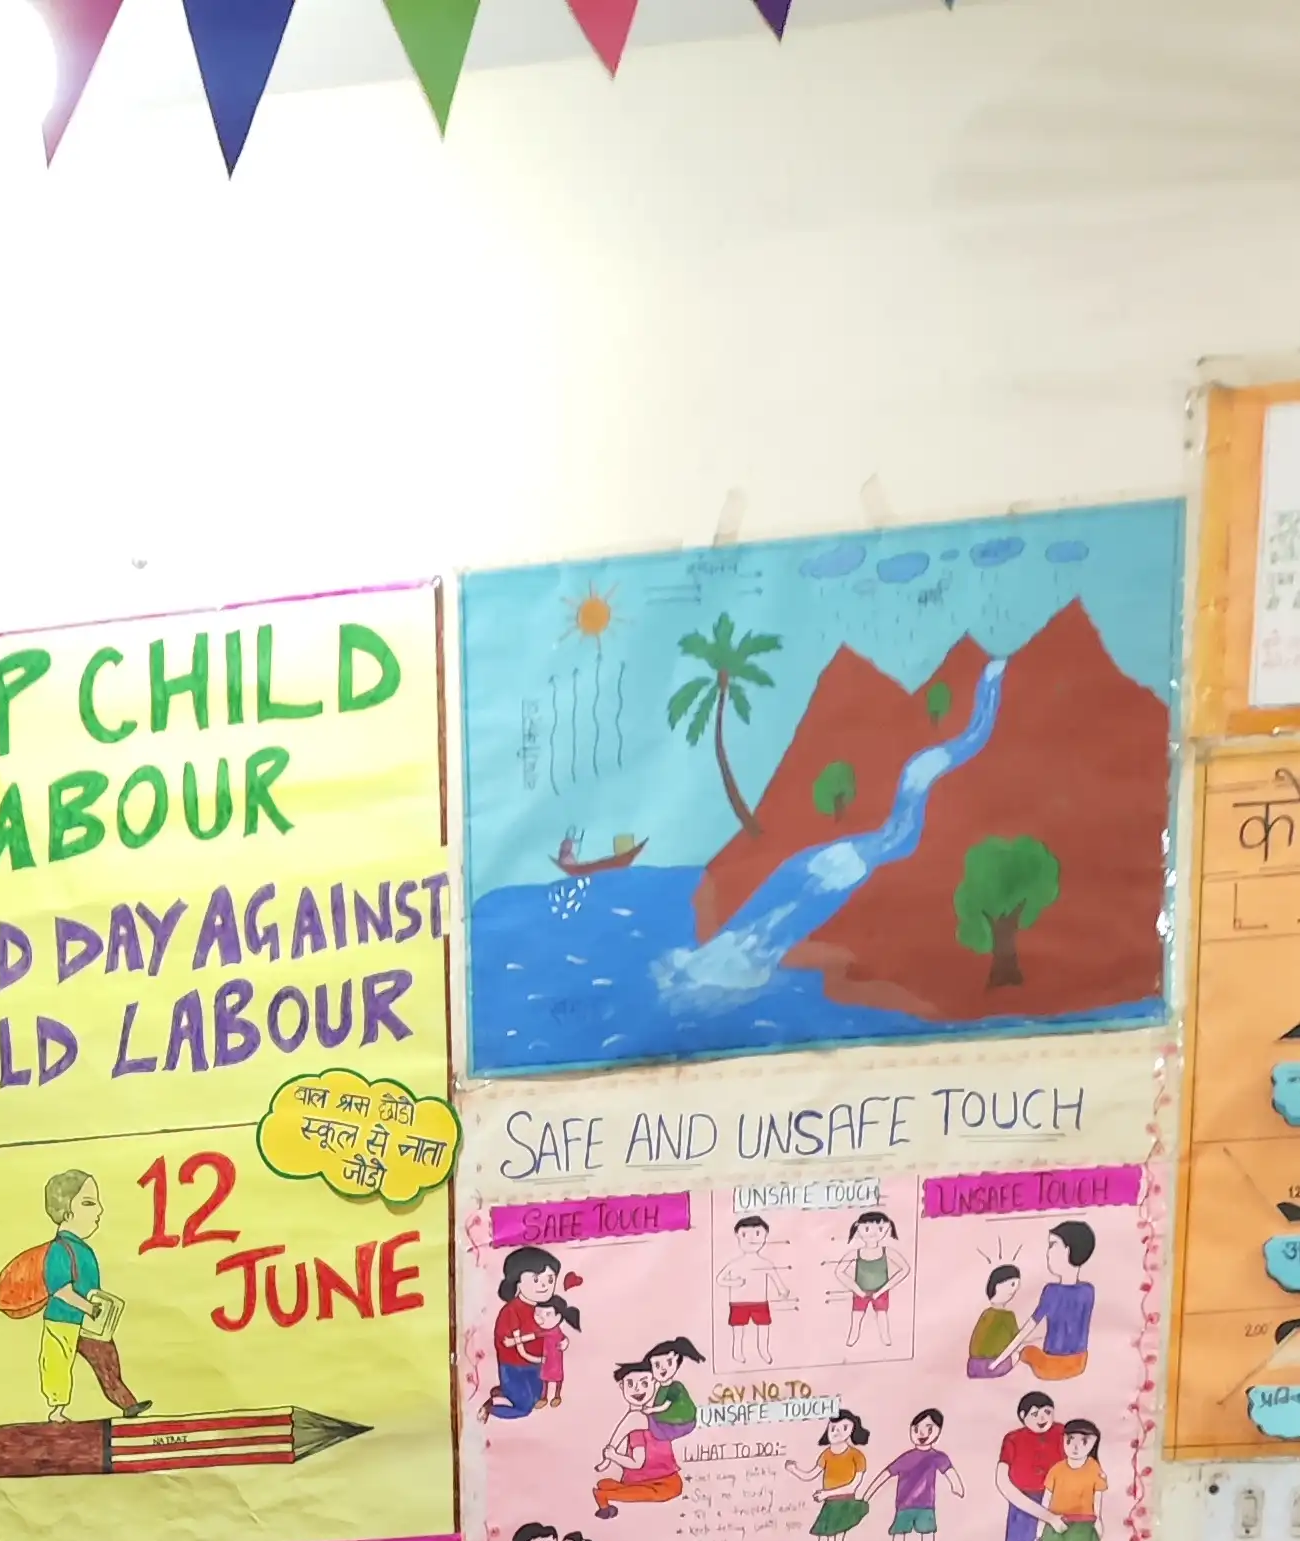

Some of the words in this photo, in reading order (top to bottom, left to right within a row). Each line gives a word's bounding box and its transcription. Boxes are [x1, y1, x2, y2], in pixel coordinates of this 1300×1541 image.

[79, 623, 401, 744] CHILD
[55, 898, 189, 984] DAY
[192, 872, 450, 970] AGAINST
[111, 969, 414, 1080] LABOUR
[335, 1093, 371, 1118] श्रम
[301, 1115, 360, 1153] स्कूल
[366, 1123, 390, 1157] से
[398, 1135, 448, 1168] नाता
[499, 1109, 604, 1180] SAFE
[625, 1112, 718, 1164] AND
[737, 1096, 916, 1160] UNSAFE
[931, 1087, 1084, 1136] TOUCH
[136, 1151, 241, 1256] 12
[738, 1183, 815, 1210] UNSAFE
[825, 1182, 881, 1203] TOUCH
[936, 1182, 1025, 1215] UNSAFE
[1033, 1171, 1109, 1206] TOUCH
[522, 1207, 584, 1242] SAFE
[592, 1203, 662, 1233] TOUCH
[209, 1230, 426, 1332] JUNE
[700, 1401, 769, 1428] UNSAFE
[783, 1399, 835, 1418] TOUCH
[708, 1382, 746, 1405] SAY
[752, 1381, 780, 1401] NO
[784, 1379, 812, 1399] TO
[683, 1443, 727, 1462] WHAT
[732, 1442, 751, 1459] TO
